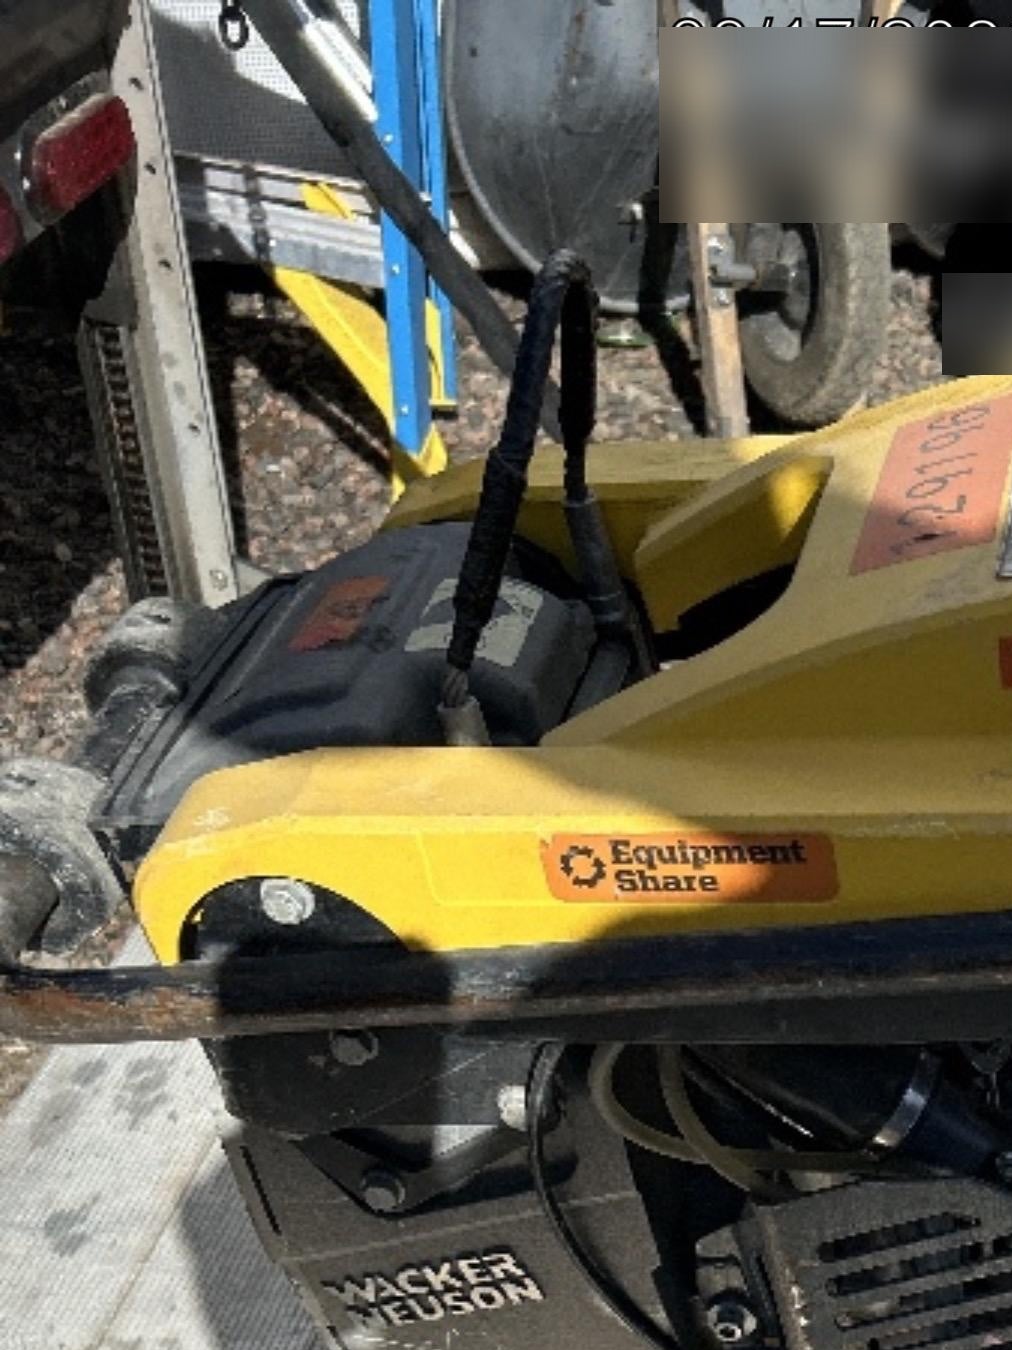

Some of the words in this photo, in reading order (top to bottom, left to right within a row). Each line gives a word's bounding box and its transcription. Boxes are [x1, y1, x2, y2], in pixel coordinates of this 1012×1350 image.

[608, 839, 807, 870] Equipment
[614, 869, 719, 892] Share
[321, 1250, 527, 1304] WACKER
